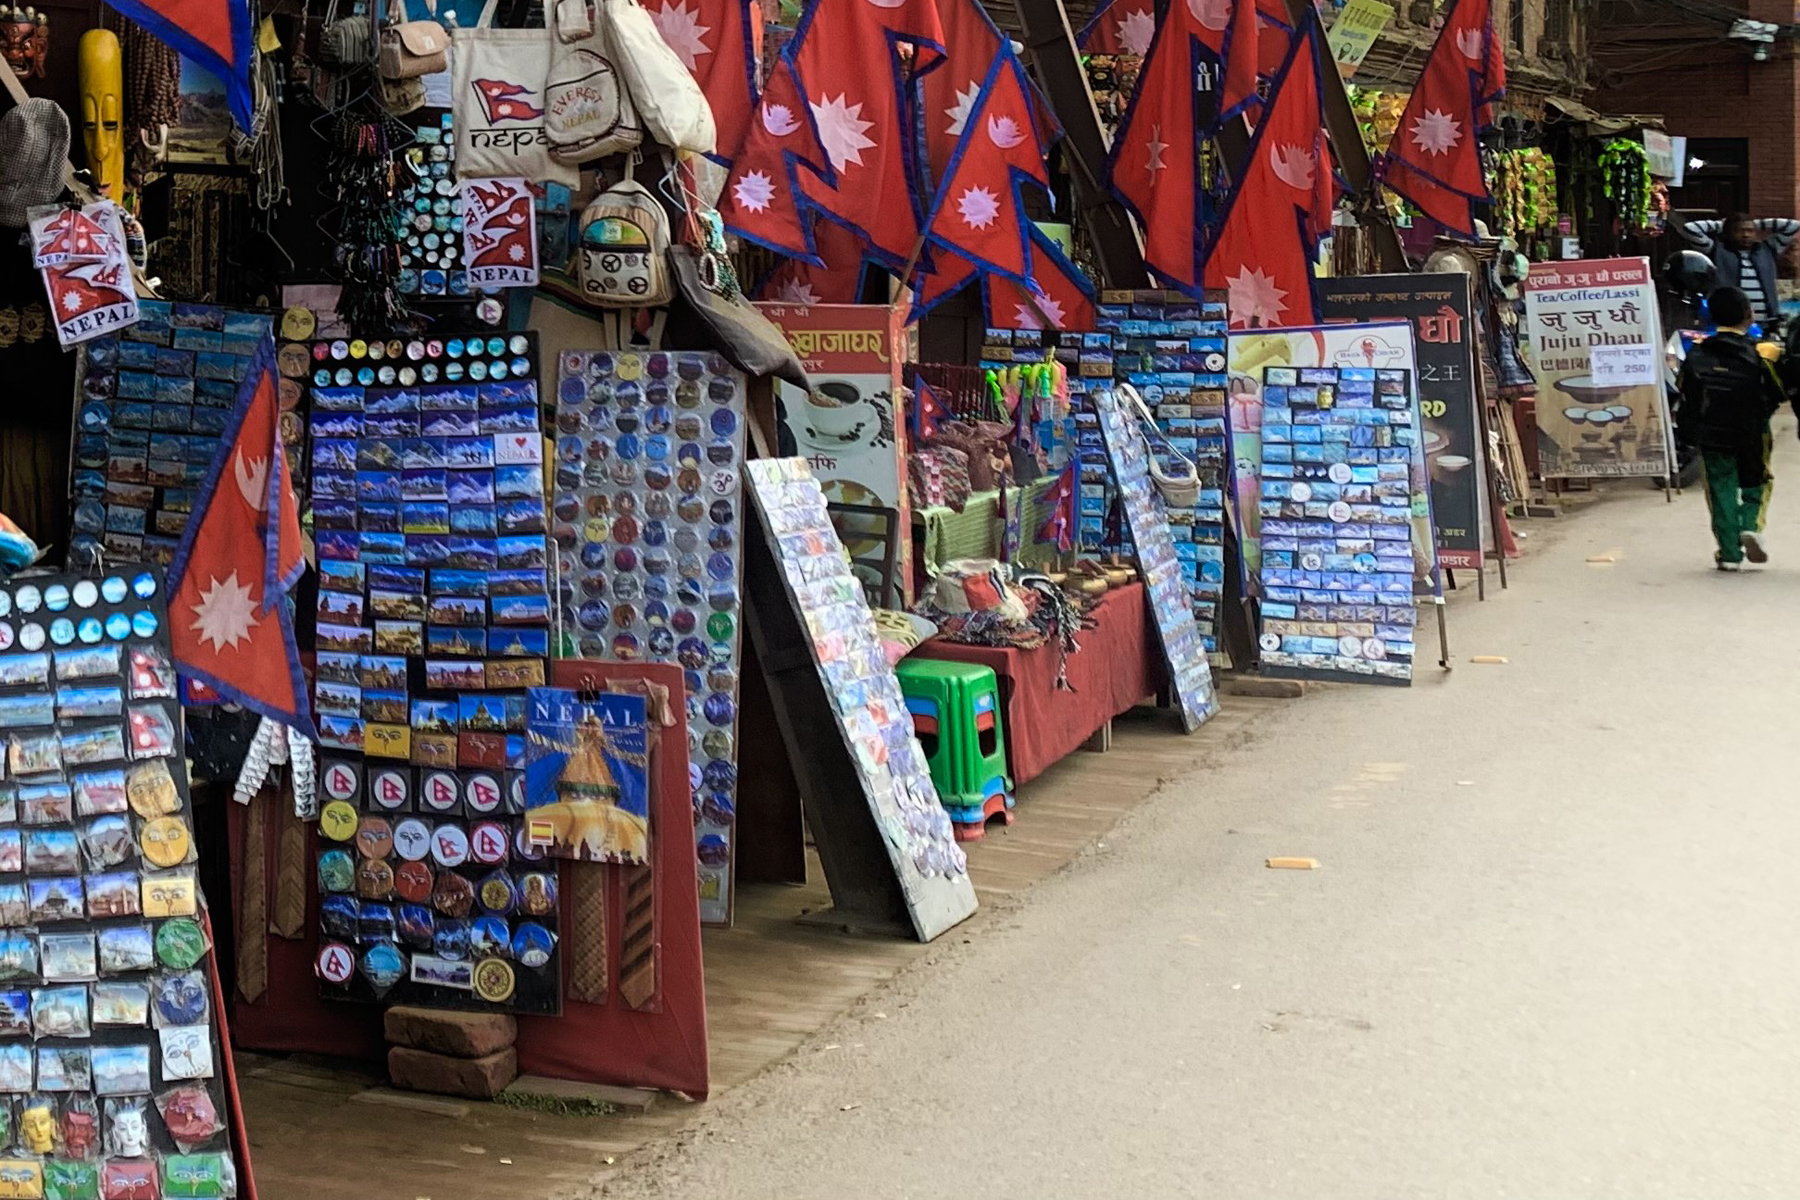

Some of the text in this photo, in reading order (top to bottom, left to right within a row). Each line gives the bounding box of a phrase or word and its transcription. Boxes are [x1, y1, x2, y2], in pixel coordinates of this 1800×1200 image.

[553, 86, 604, 116] EVEREST
[562, 109, 600, 130] NEPAL
[470, 268, 534, 284] NEPAL
[1535, 288, 1640, 303] Tea/Coffee/Lassi
[61, 305, 135, 340] NEPAL
[1541, 332, 1643, 352] Juju Dhau
[535, 702, 637, 727] NEPAL
